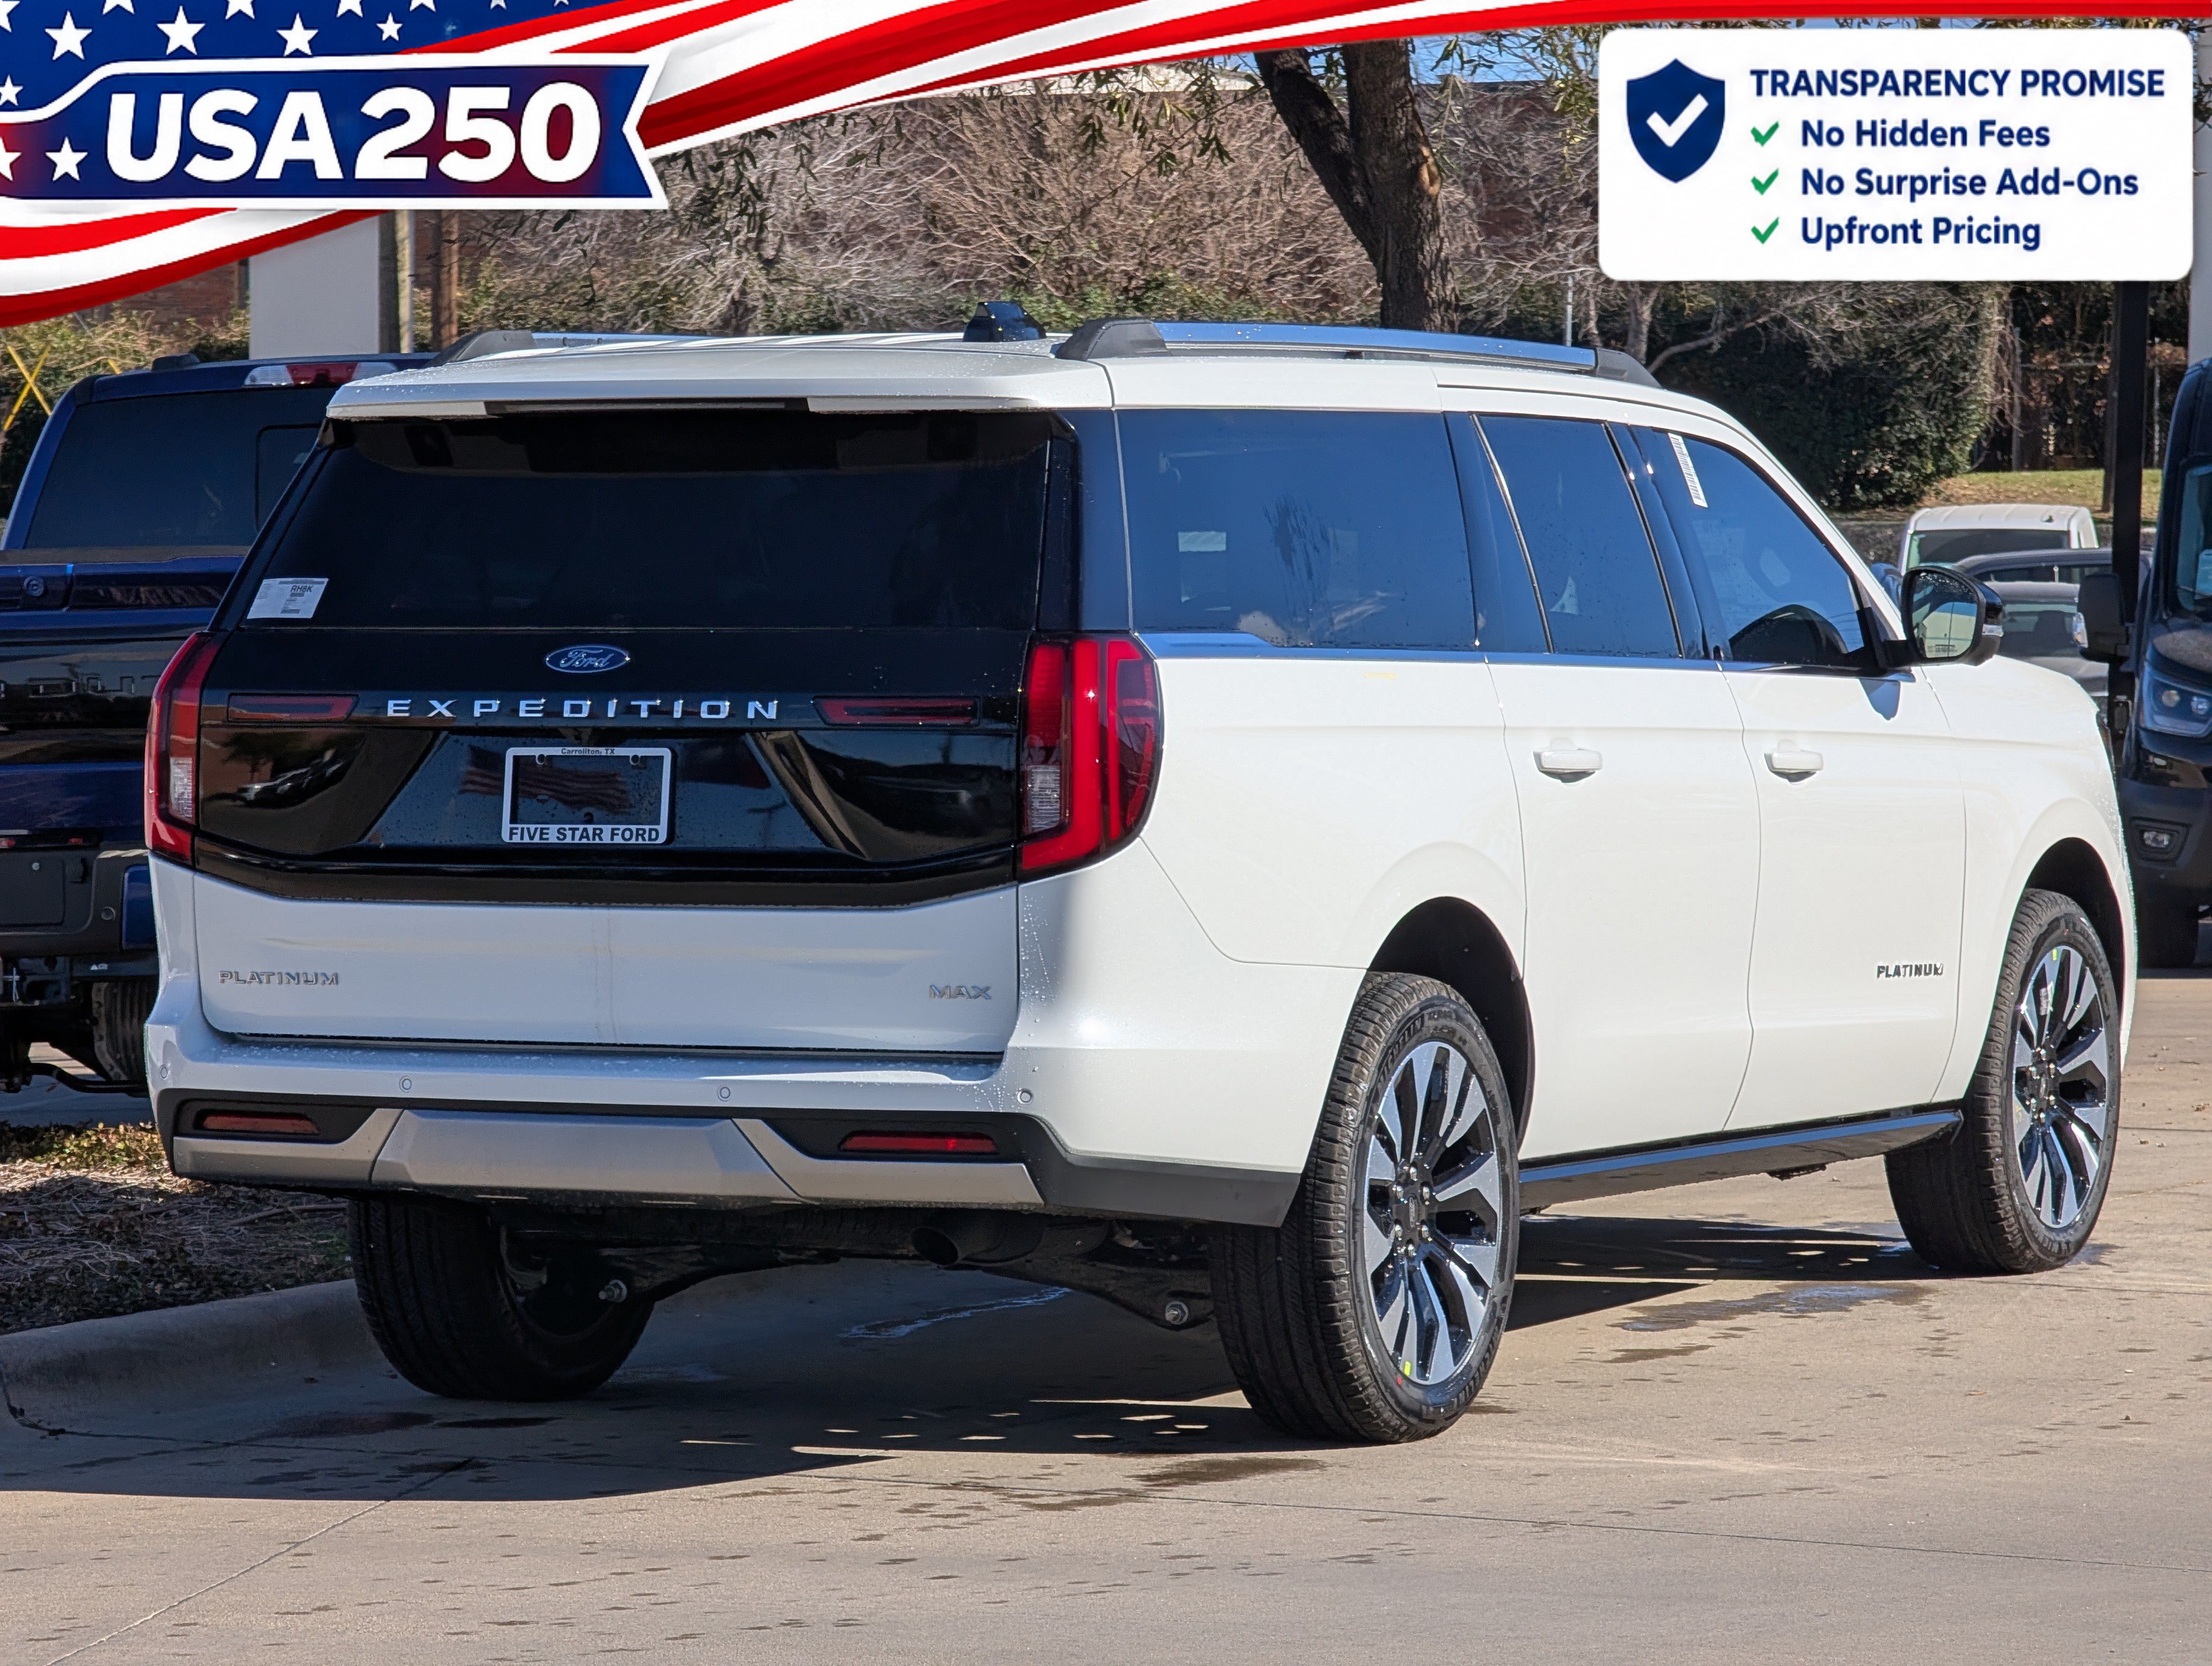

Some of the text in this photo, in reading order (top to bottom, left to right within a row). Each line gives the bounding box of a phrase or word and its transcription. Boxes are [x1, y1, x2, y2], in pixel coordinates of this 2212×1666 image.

[559, 649, 614, 668] Ford
[386, 697, 779, 721] EXPEDITION
[509, 826, 660, 842] FIVE STAR FORD
[218, 970, 339, 986] PLATINUM
[1876, 963, 1944, 979] PLATINUM
[929, 984, 992, 1000] MAX
